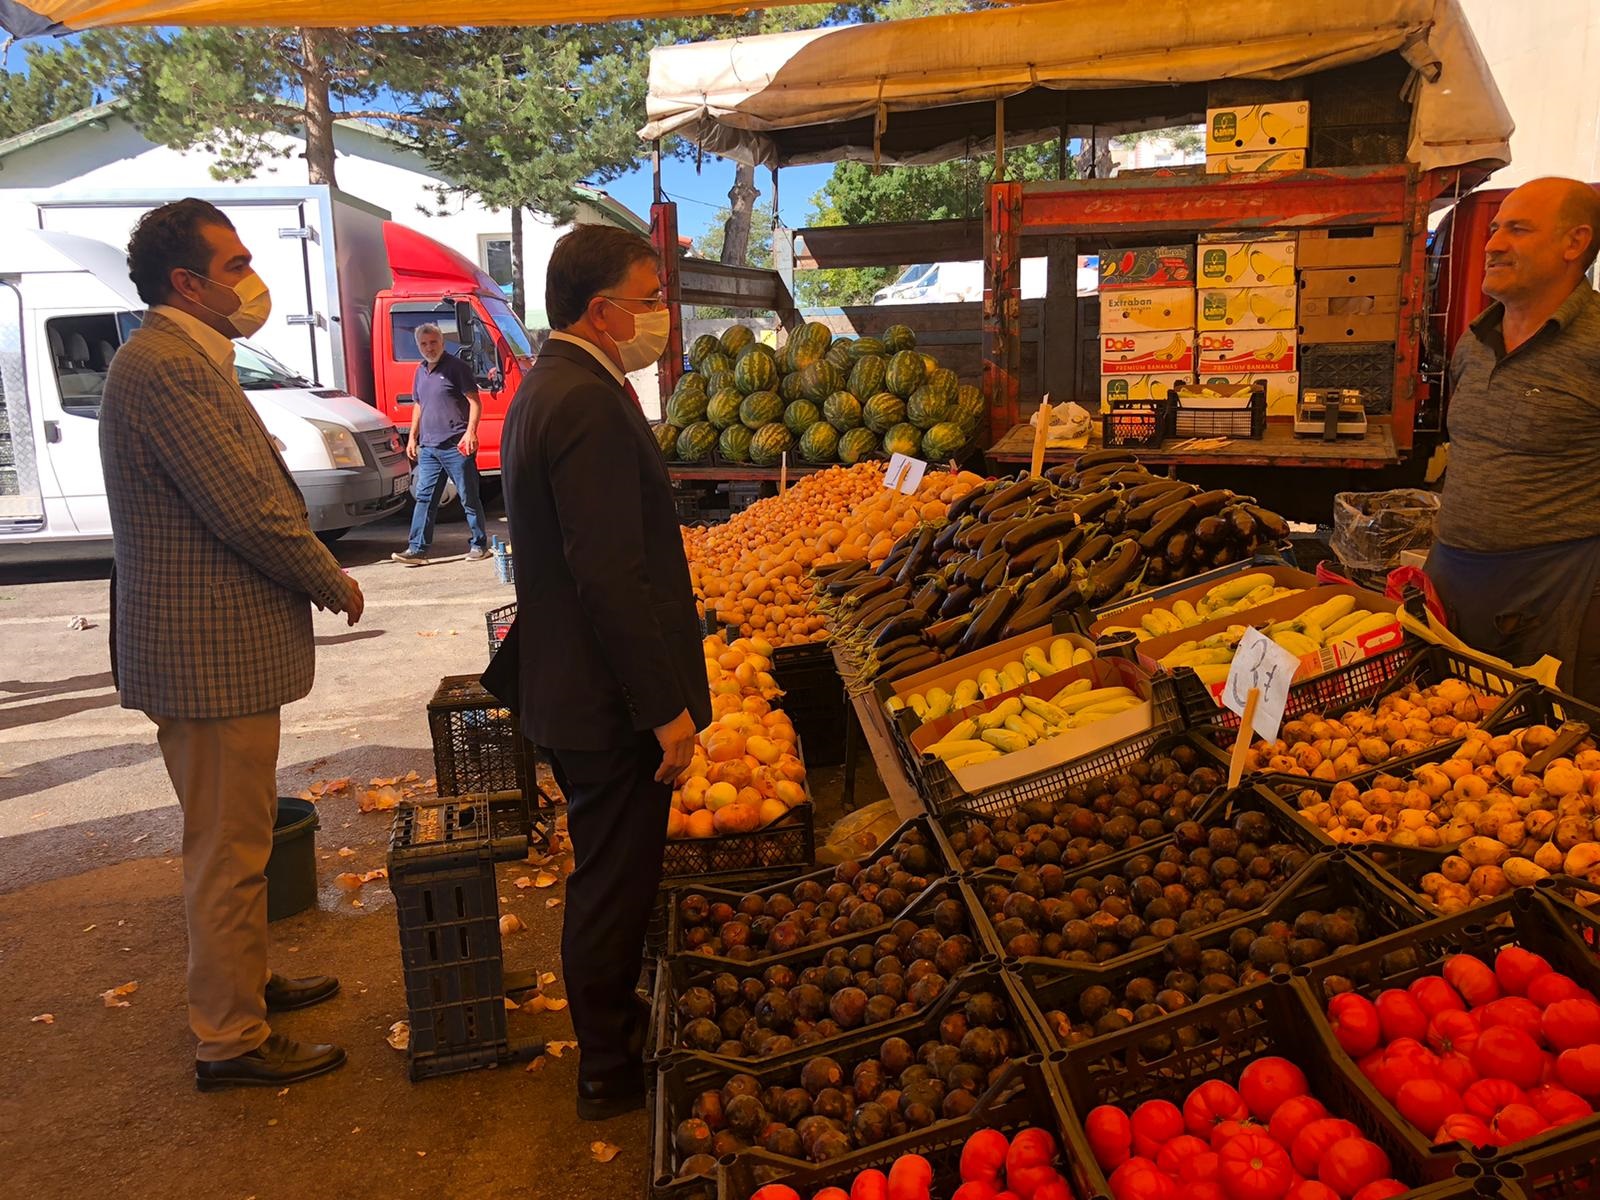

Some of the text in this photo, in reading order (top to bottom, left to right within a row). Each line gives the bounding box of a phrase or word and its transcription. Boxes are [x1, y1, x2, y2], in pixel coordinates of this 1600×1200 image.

[1108, 298, 1152, 307] Extraban
[1105, 337, 1135, 349] Dole
[1202, 335, 1234, 349] Dole
